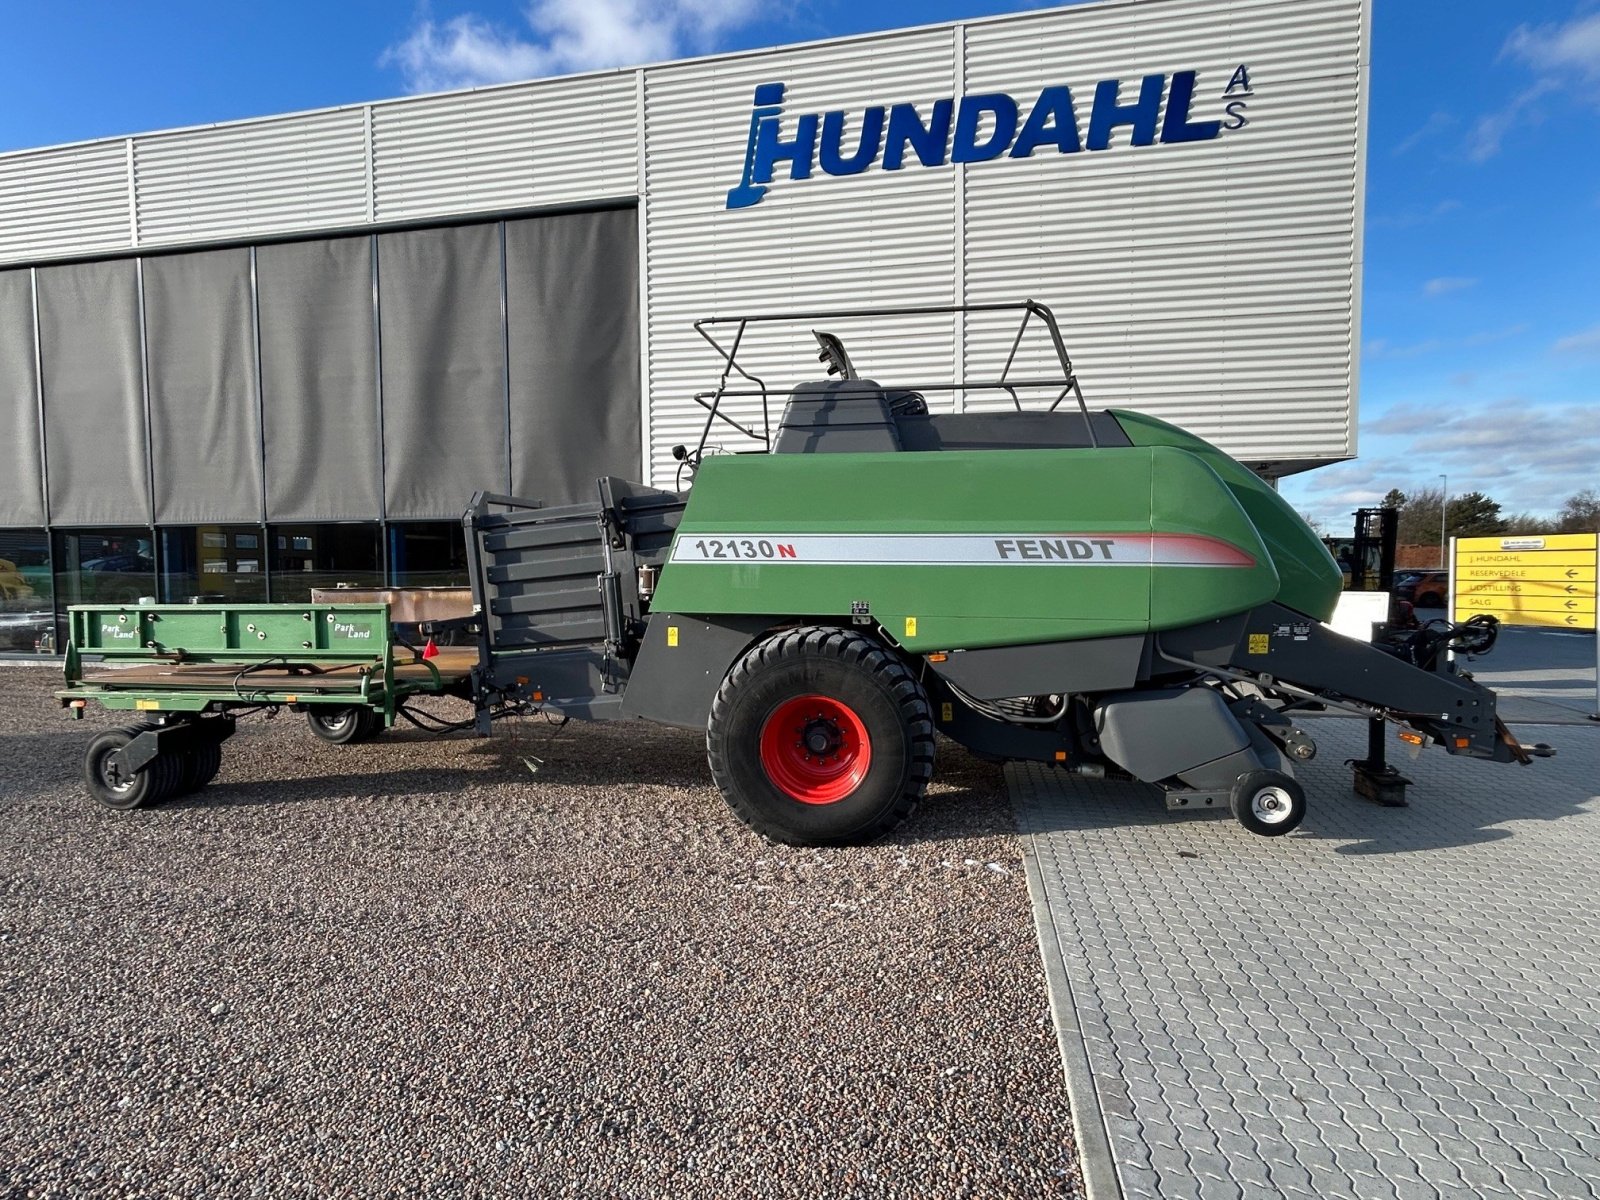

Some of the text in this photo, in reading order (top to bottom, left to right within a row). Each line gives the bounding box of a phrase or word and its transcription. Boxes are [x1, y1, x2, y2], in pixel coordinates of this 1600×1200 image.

[695, 540, 797, 559] 12130 N
[994, 539, 1115, 560] FENDT
[101, 624, 120, 632] Park
[334, 623, 355, 632] Park
[114, 630, 134, 639] Land
[347, 629, 370, 638] Land
